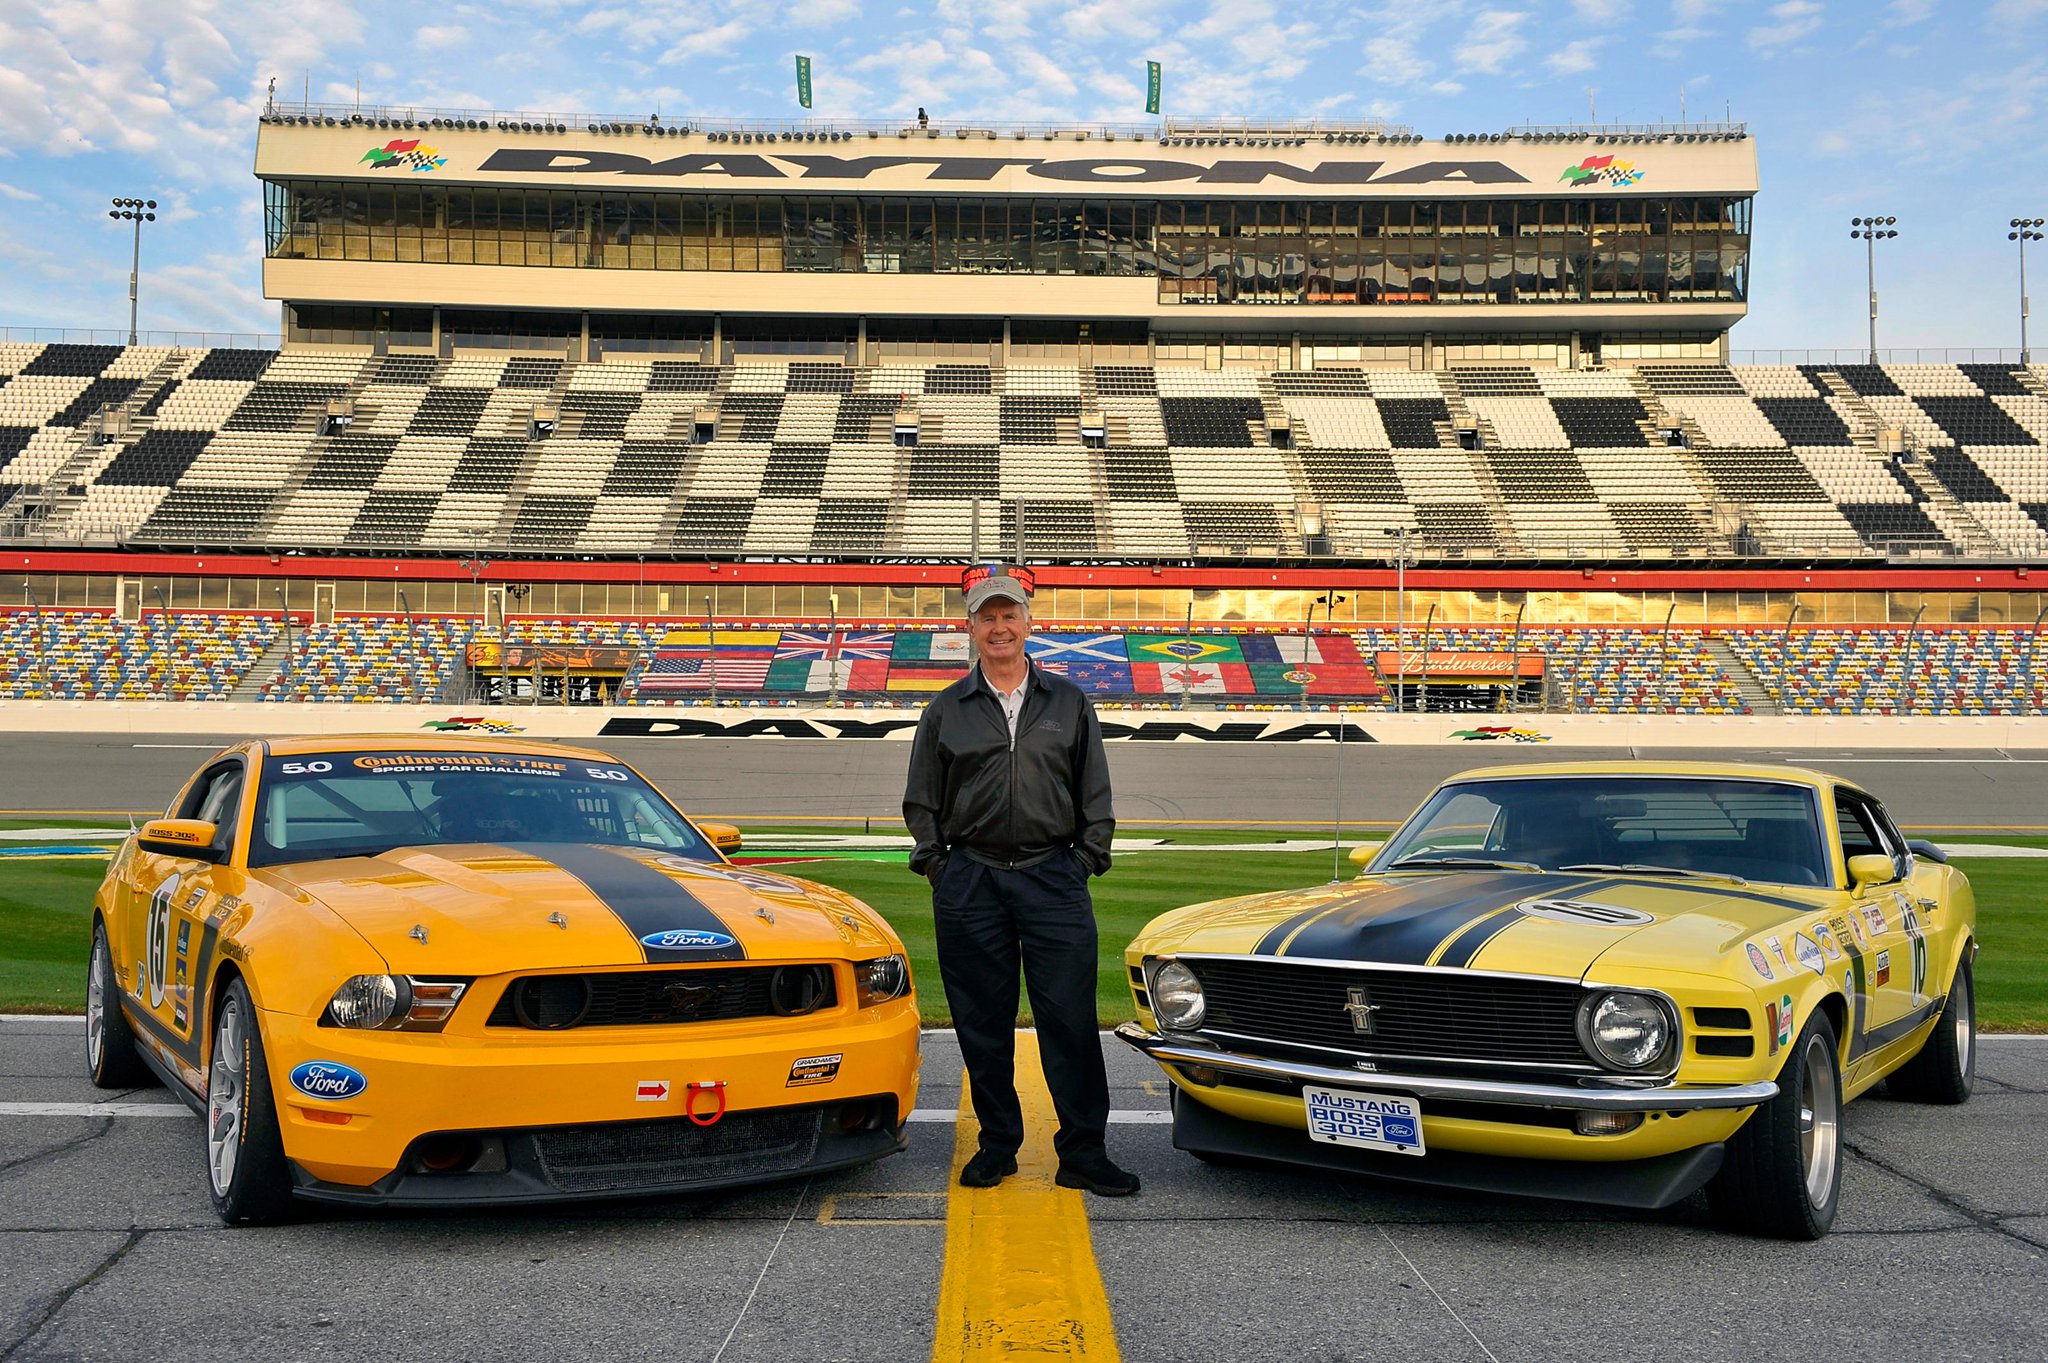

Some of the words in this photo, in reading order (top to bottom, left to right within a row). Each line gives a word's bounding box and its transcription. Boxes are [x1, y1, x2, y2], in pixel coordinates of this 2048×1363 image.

[477, 148, 1533, 184] DAYTONA
[1402, 652, 1521, 673] Budweiser
[353, 754, 493, 769] Continental
[516, 759, 568, 771] TIRE
[372, 765, 435, 773] SPORTS
[475, 766, 561, 777] CHALLENGE
[149, 828, 173, 837] BOSS
[1829, 916, 1847, 931] BOSS
[661, 931, 717, 945] Ford
[1838, 932, 1853, 946] 302
[793, 1064, 829, 1077] Continental
[303, 1065, 350, 1094] Ford
[1311, 1093, 1411, 1115] MUSTANG
[1312, 1107, 1381, 1127] BOSS
[1318, 1121, 1378, 1138] 302
[1390, 1125, 1408, 1136] Ford
